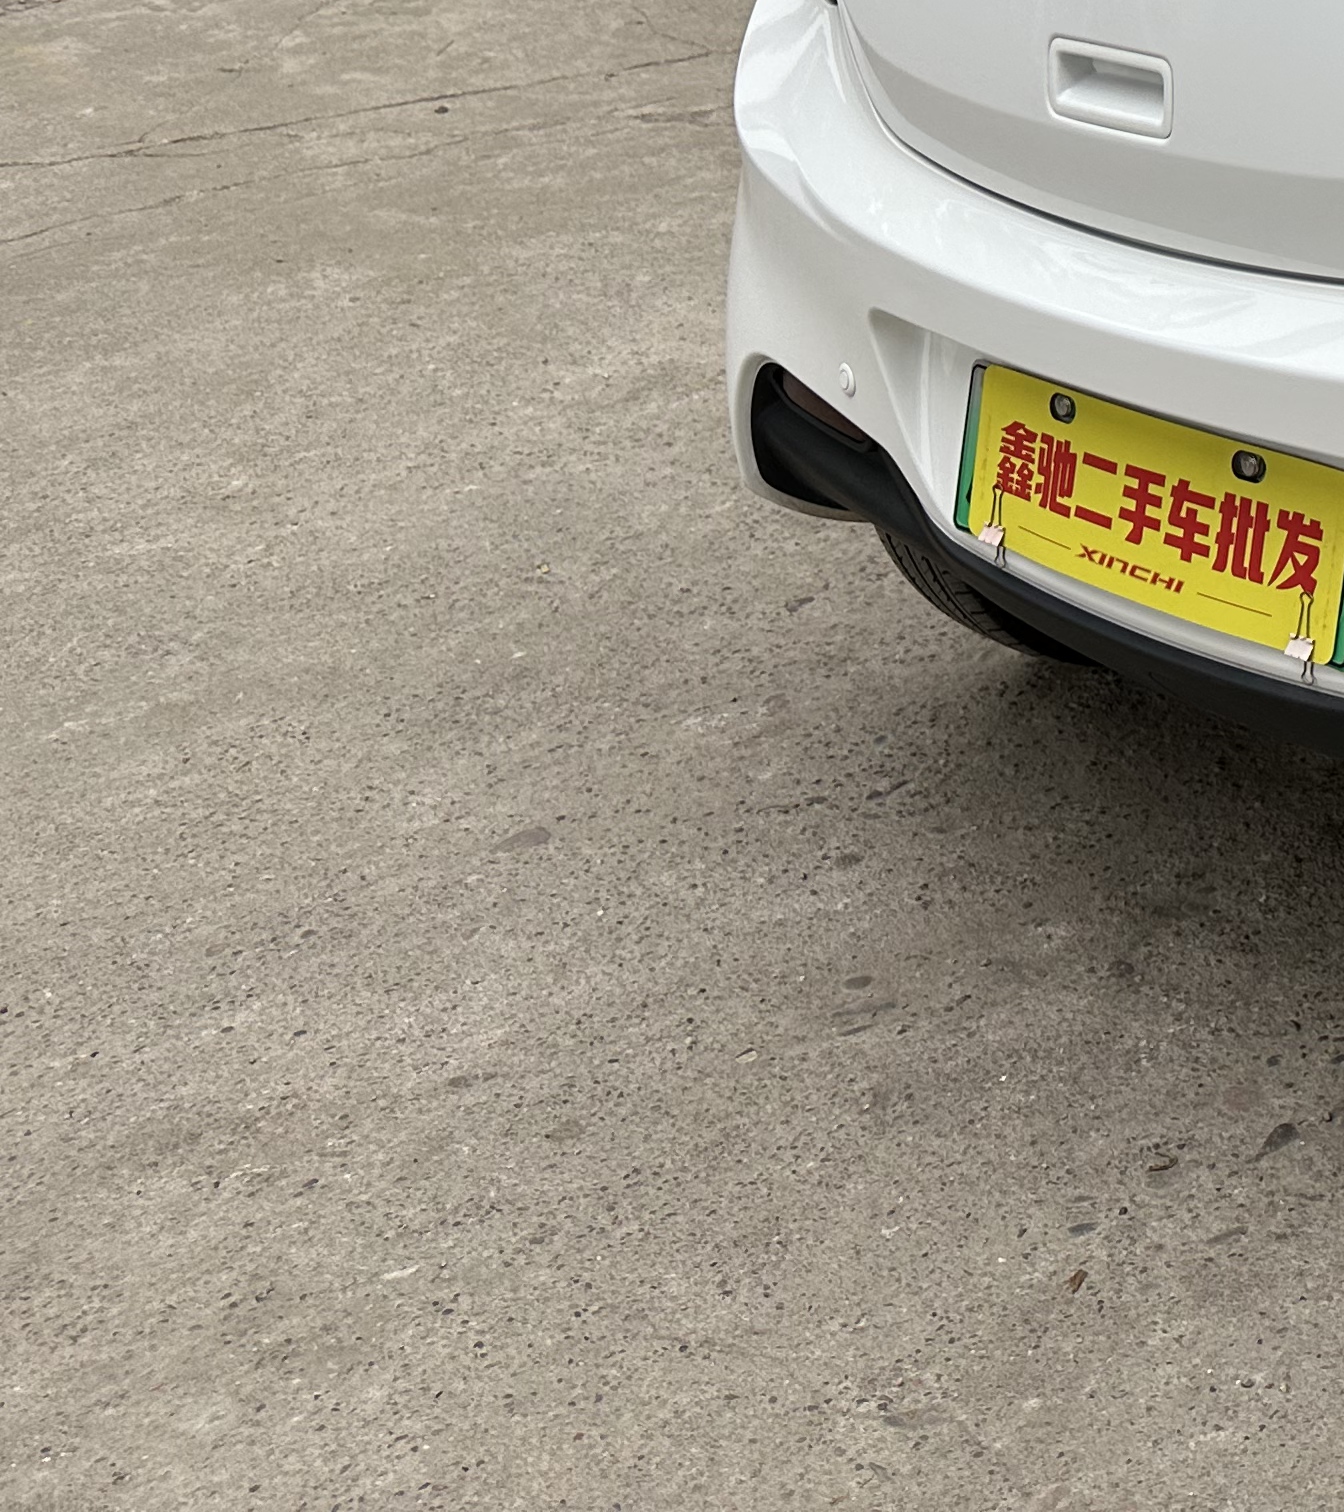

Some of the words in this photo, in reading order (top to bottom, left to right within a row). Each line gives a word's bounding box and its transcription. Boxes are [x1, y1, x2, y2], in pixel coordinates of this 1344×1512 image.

[997, 420, 1325, 596] 鑫驰二手车批发
[1075, 543, 1186, 595] XINCHI
